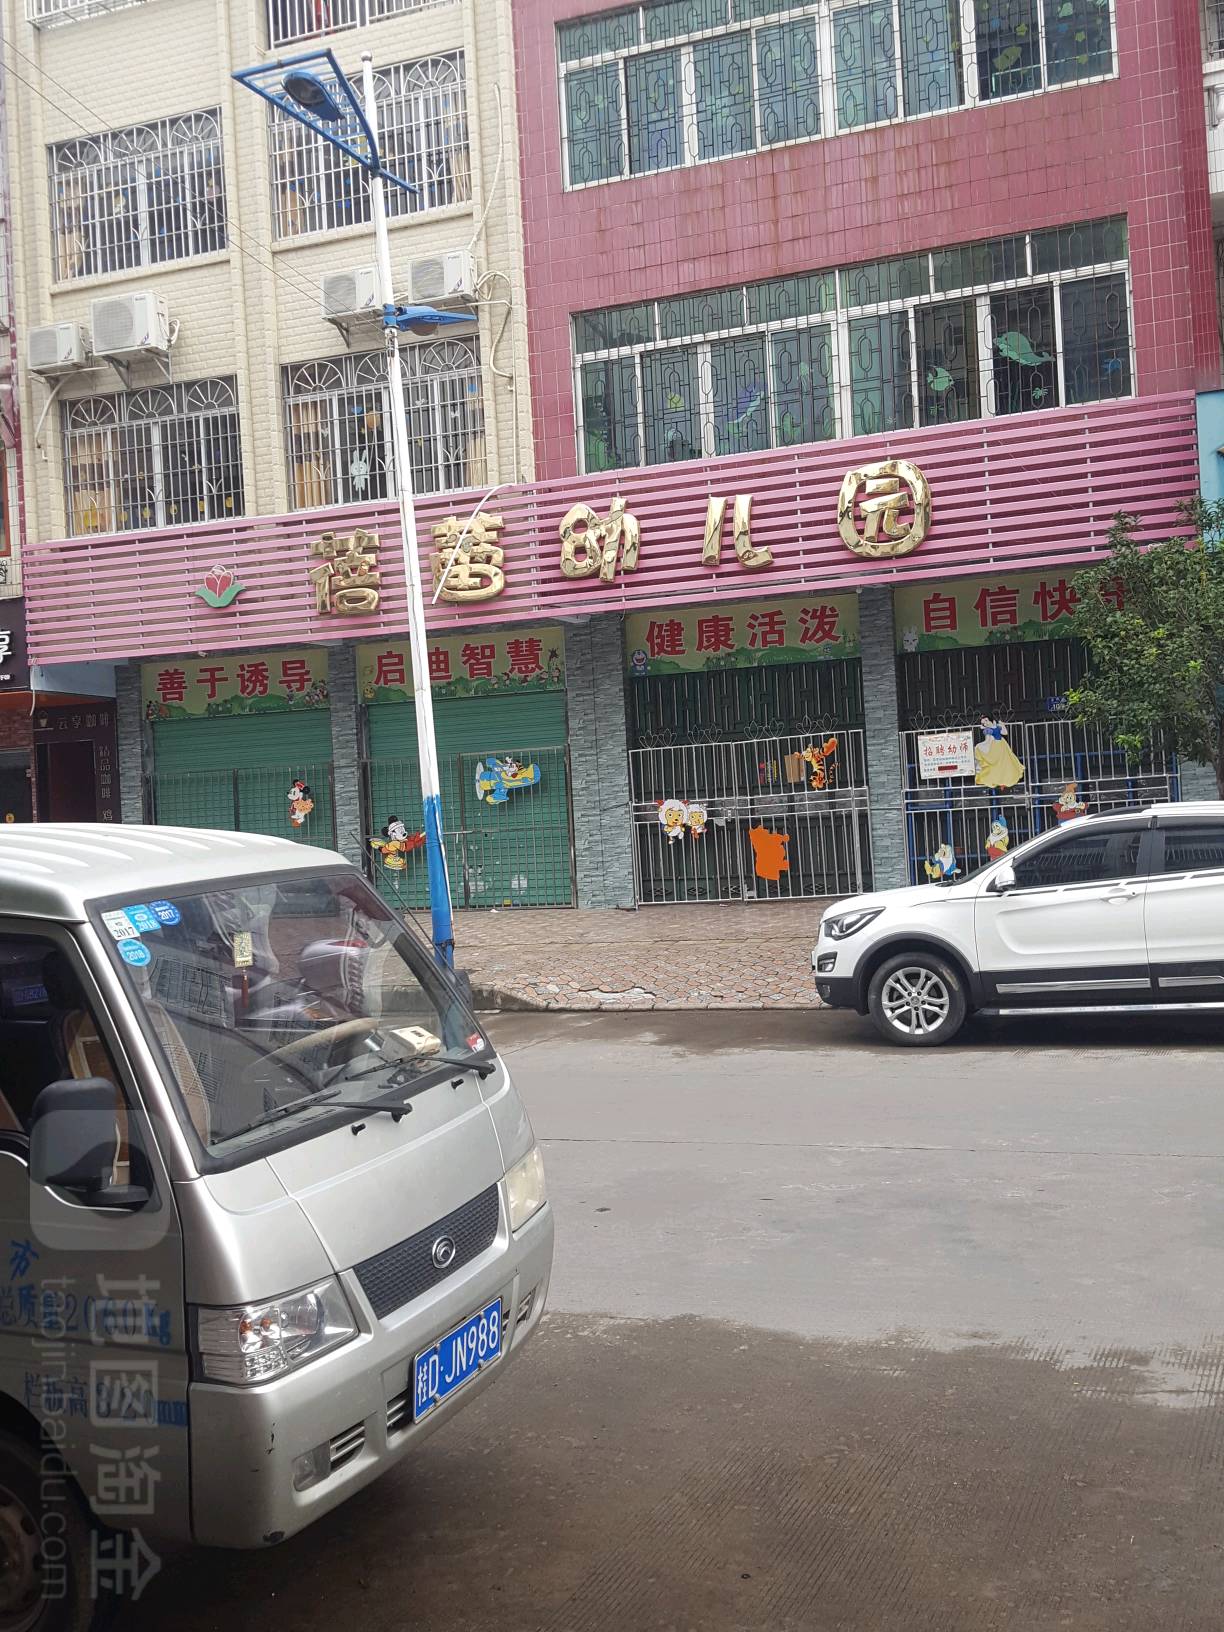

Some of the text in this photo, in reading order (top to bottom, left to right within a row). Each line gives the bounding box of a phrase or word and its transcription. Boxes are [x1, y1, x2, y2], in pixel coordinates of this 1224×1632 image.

[310, 459, 933, 615] 蓓蕾幼儿园
[645, 605, 842, 658] 健康活泼
[156, 659, 313, 703] 善于诱导
[374, 638, 545, 686] 启迪智慧
[923, 738, 969, 757] 招聘幼师
[113, 926, 135, 938] 2017
